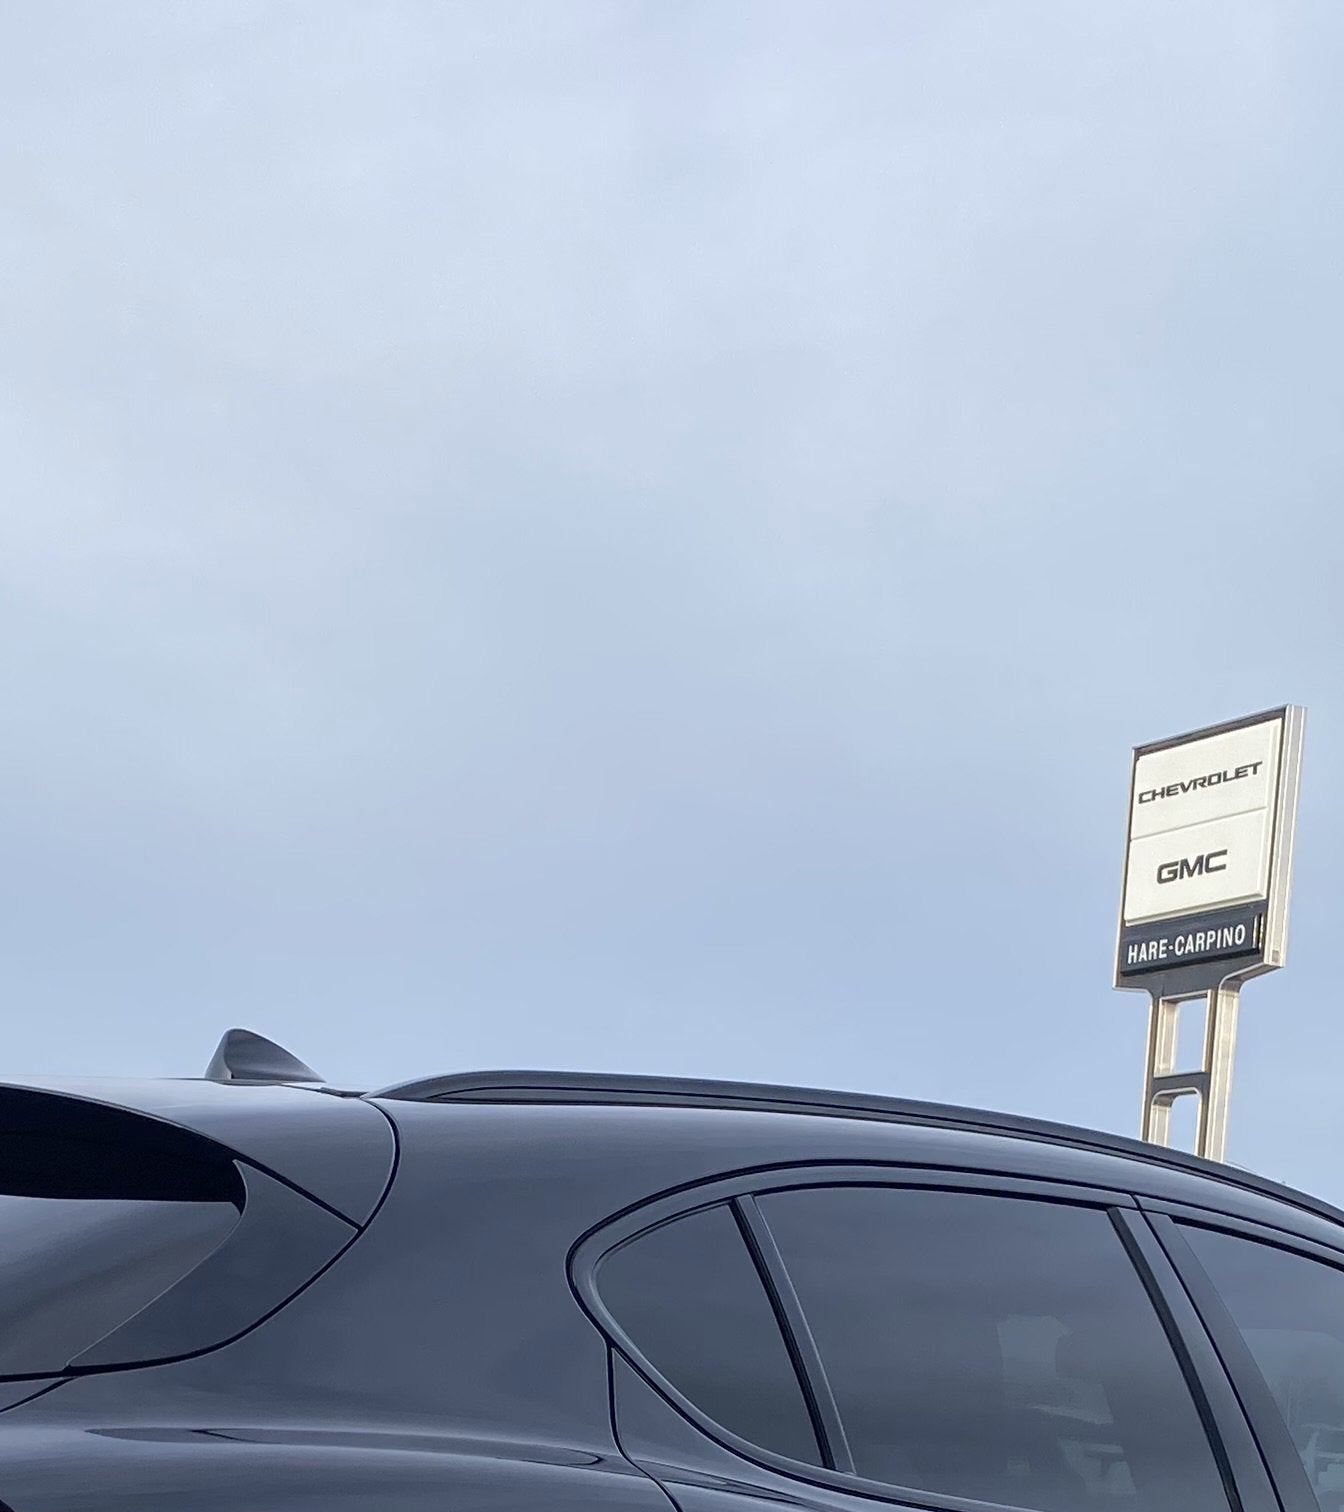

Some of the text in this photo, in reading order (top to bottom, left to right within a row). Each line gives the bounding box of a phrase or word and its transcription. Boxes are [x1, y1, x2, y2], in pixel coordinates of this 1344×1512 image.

[1138, 761, 1263, 804] CHEVROLET
[1156, 849, 1228, 885] GMC
[1127, 924, 1246, 964] HARE-CARPINO
